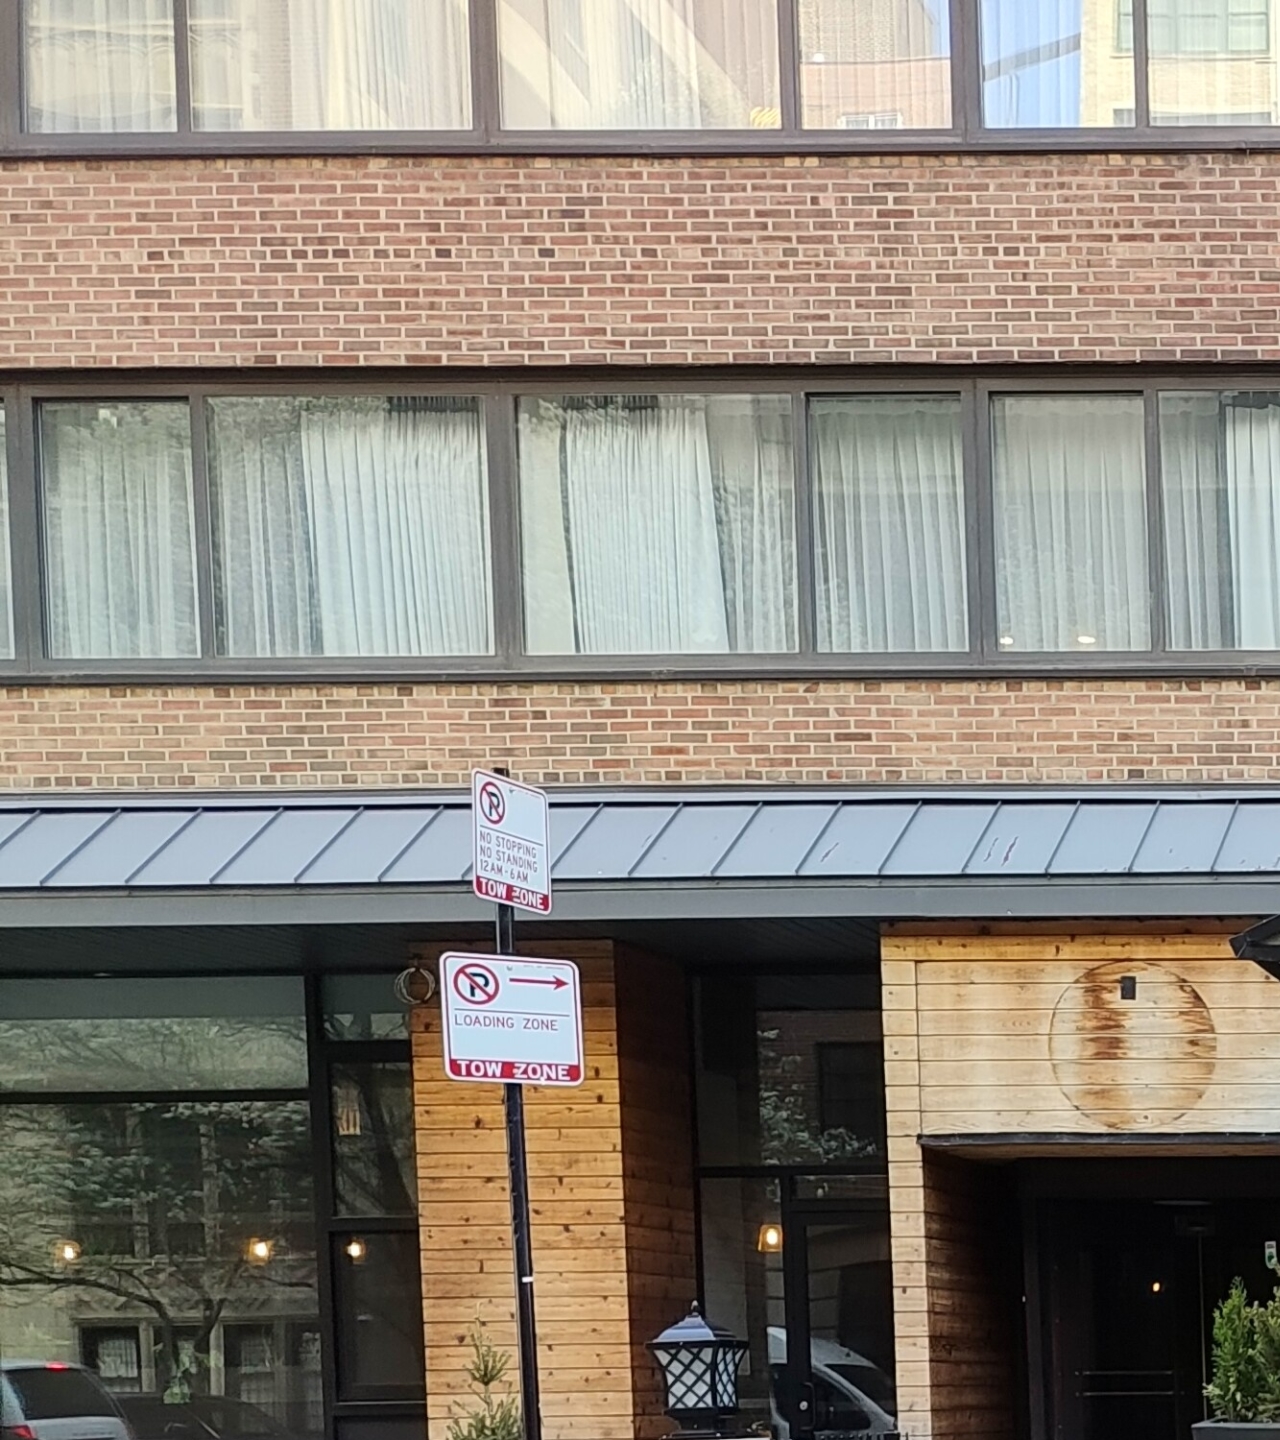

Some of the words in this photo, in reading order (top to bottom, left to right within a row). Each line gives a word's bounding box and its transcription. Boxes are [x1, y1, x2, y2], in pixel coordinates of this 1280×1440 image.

[480, 831, 492, 844] NO
[495, 835, 537, 859] STOPPING
[480, 844, 492, 859] NO
[495, 850, 538, 873] STANDING
[480, 879, 507, 899] TOW
[511, 887, 545, 909] ZONE
[454, 1014, 515, 1029] LOADING
[523, 1018, 559, 1031] ZONE
[456, 1060, 503, 1078] TOW
[514, 1063, 571, 1081] ZONE
